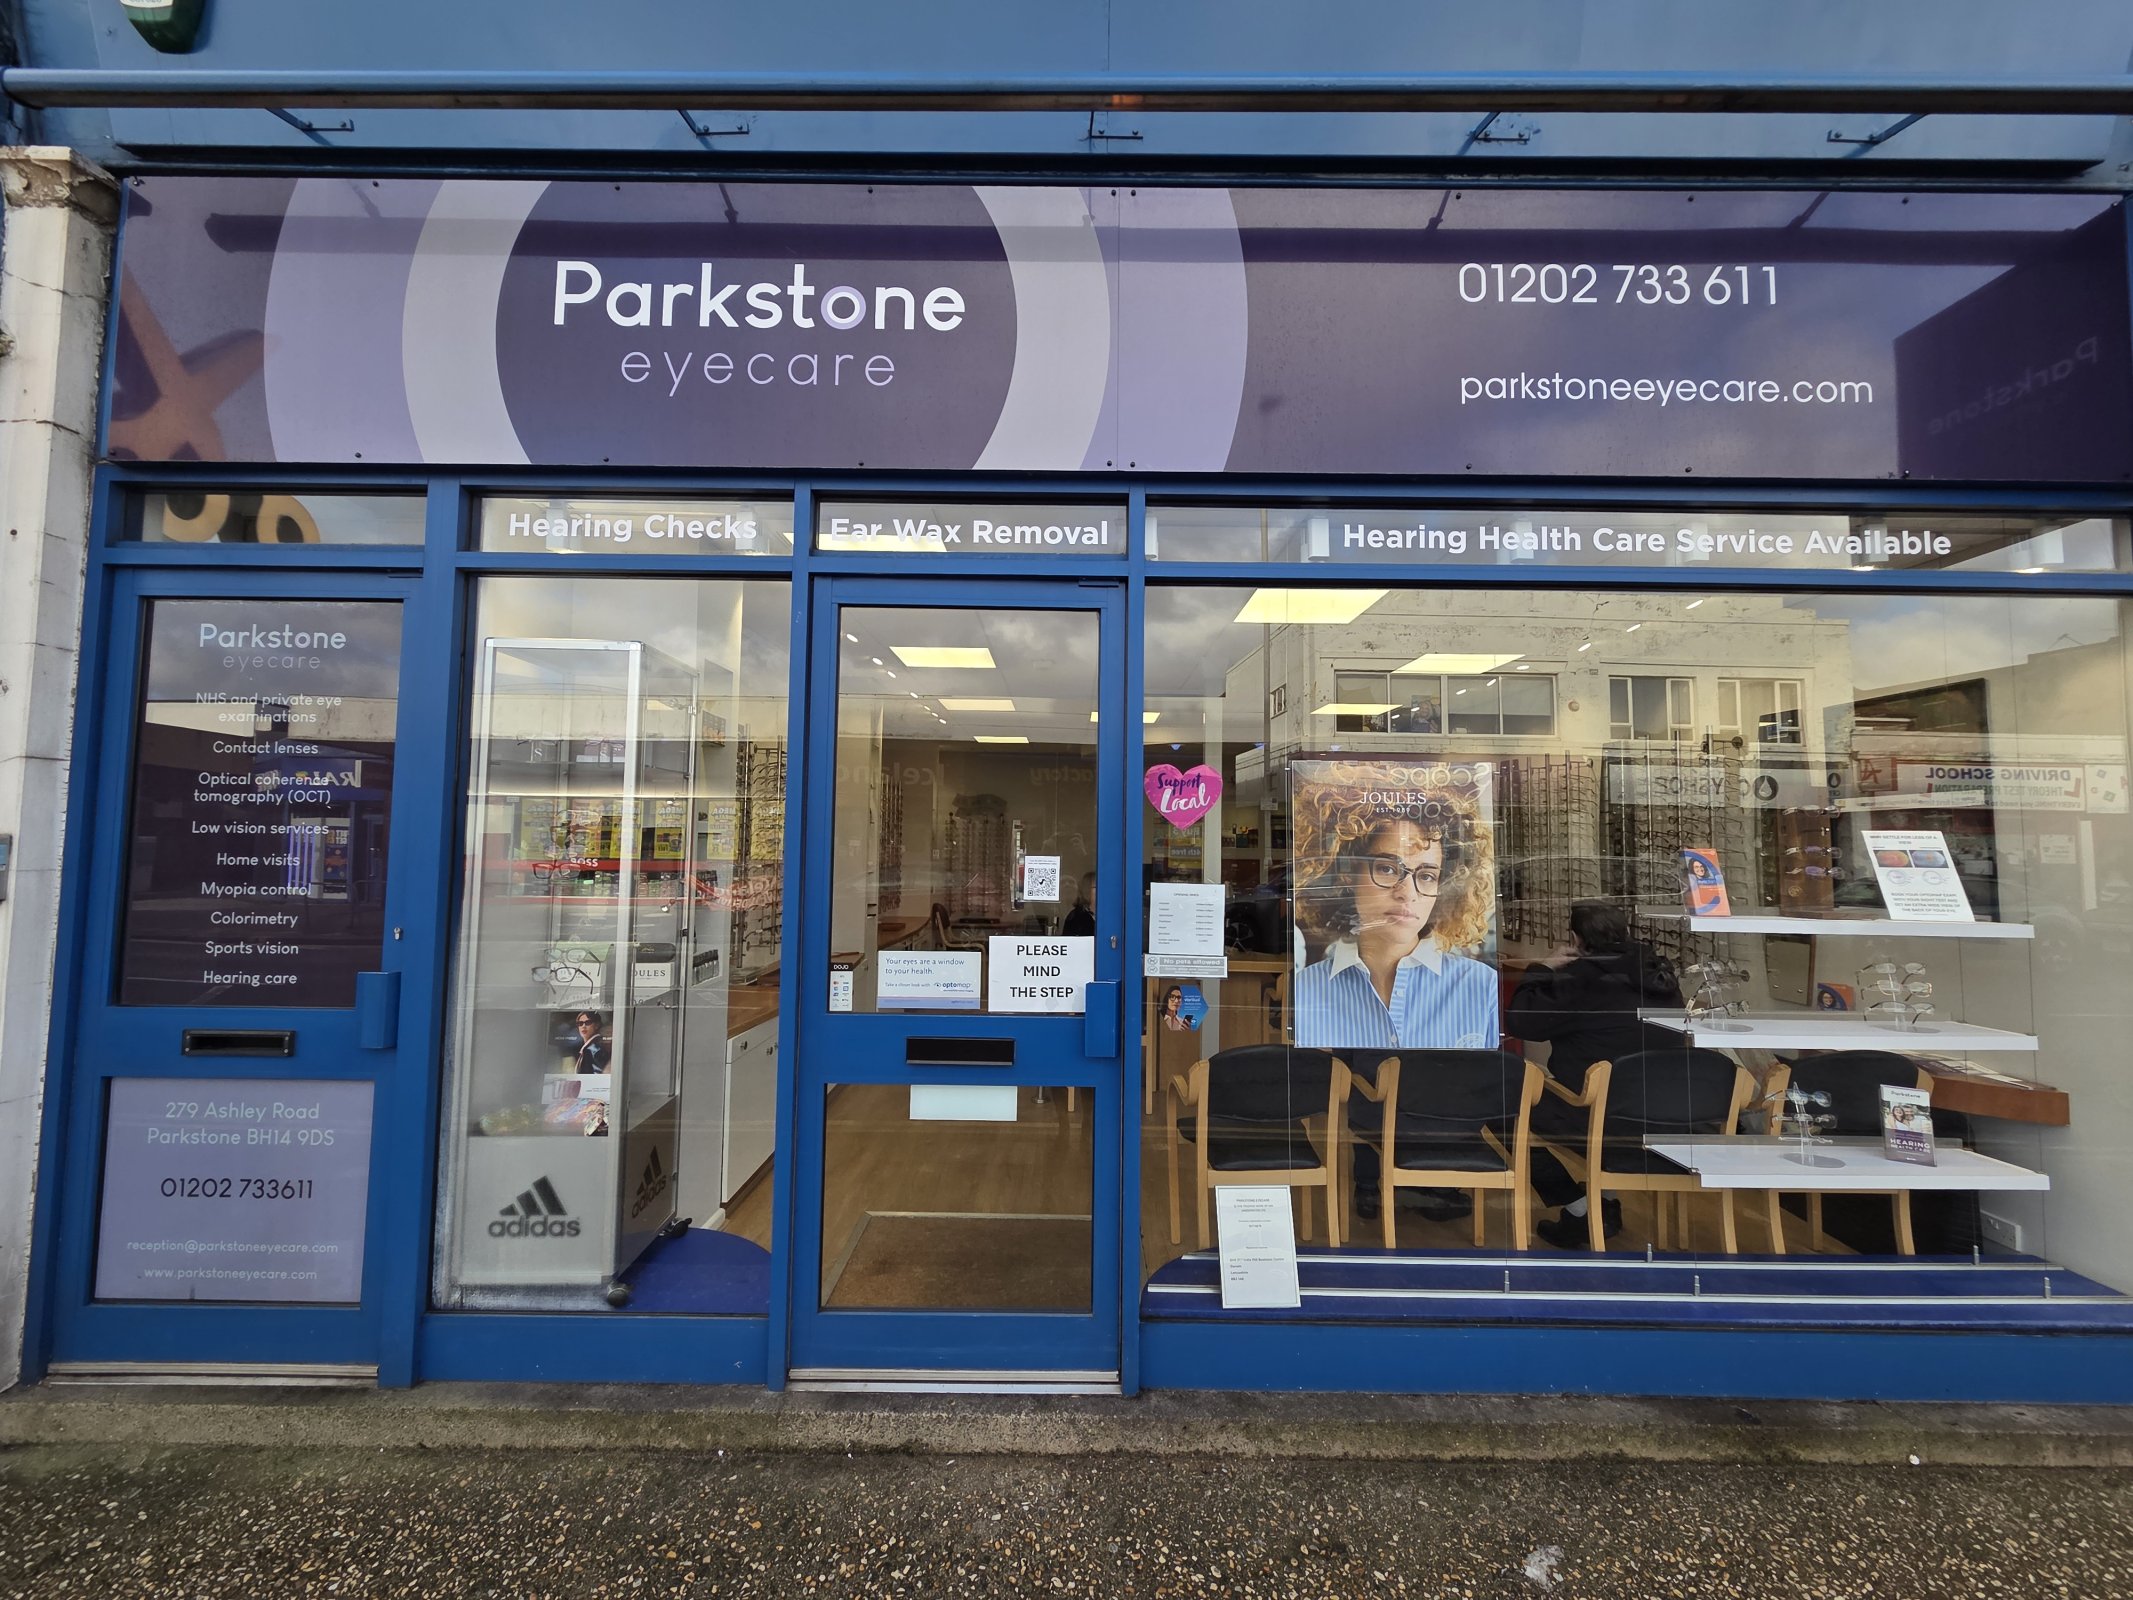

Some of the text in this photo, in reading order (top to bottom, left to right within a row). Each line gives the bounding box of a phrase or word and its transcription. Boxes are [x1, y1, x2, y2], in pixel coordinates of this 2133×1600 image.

[1459, 262, 1779, 306] 01202 733 611
[553, 260, 966, 331] Parkstone
[620, 351, 896, 397] eyecare
[1460, 372, 1873, 407] parkstoneeyecare.com
[508, 512, 757, 545] Hearing Checks
[831, 519, 1108, 546] Ear Wax Removal
[1344, 525, 1952, 556] Hearing Health Care Service Available
[199, 623, 347, 649] Parkstone
[223, 653, 321, 673] eyecare
[195, 692, 342, 711] NHS and private eye
[218, 709, 317, 723] examinations
[213, 741, 319, 755] Contact lenses
[198, 772, 329, 789] Optical coherence
[1157, 772, 1202, 796] Support
[194, 789, 331, 807] tomography (OCT)
[1161, 783, 1211, 813] Local
[1359, 791, 1427, 805] JOULES
[191, 821, 329, 836] Low vision services
[216, 852, 301, 867] Home visits
[201, 882, 312, 899] Myopia control
[210, 912, 298, 928] Colorimetry
[205, 941, 299, 957] Sports vision
[1016, 945, 1068, 956] PLEASE
[886, 957, 902, 966] Your
[903, 959, 918, 967] eyes
[938, 957, 965, 966] window
[1164, 957, 1221, 966] No pets allowed
[203, 971, 297, 987] Hearing care
[885, 967, 934, 977] to your health.
[1023, 966, 1061, 977] MIND
[1010, 986, 1074, 998] THE STEP
[165, 1102, 320, 1123] 279 Ashley Road
[148, 1128, 334, 1146] Parkstone BH14 9DS
[1890, 1138, 1931, 1149] HEARING
[161, 1178, 313, 1199] 01202 733611
[631, 1174, 667, 1220] adidas
[488, 1214, 581, 1238] adidas
[127, 1239, 338, 1254] reception@parkstoneeyecare.com
[144, 1268, 317, 1281] www.parkstoneeyecare.com
